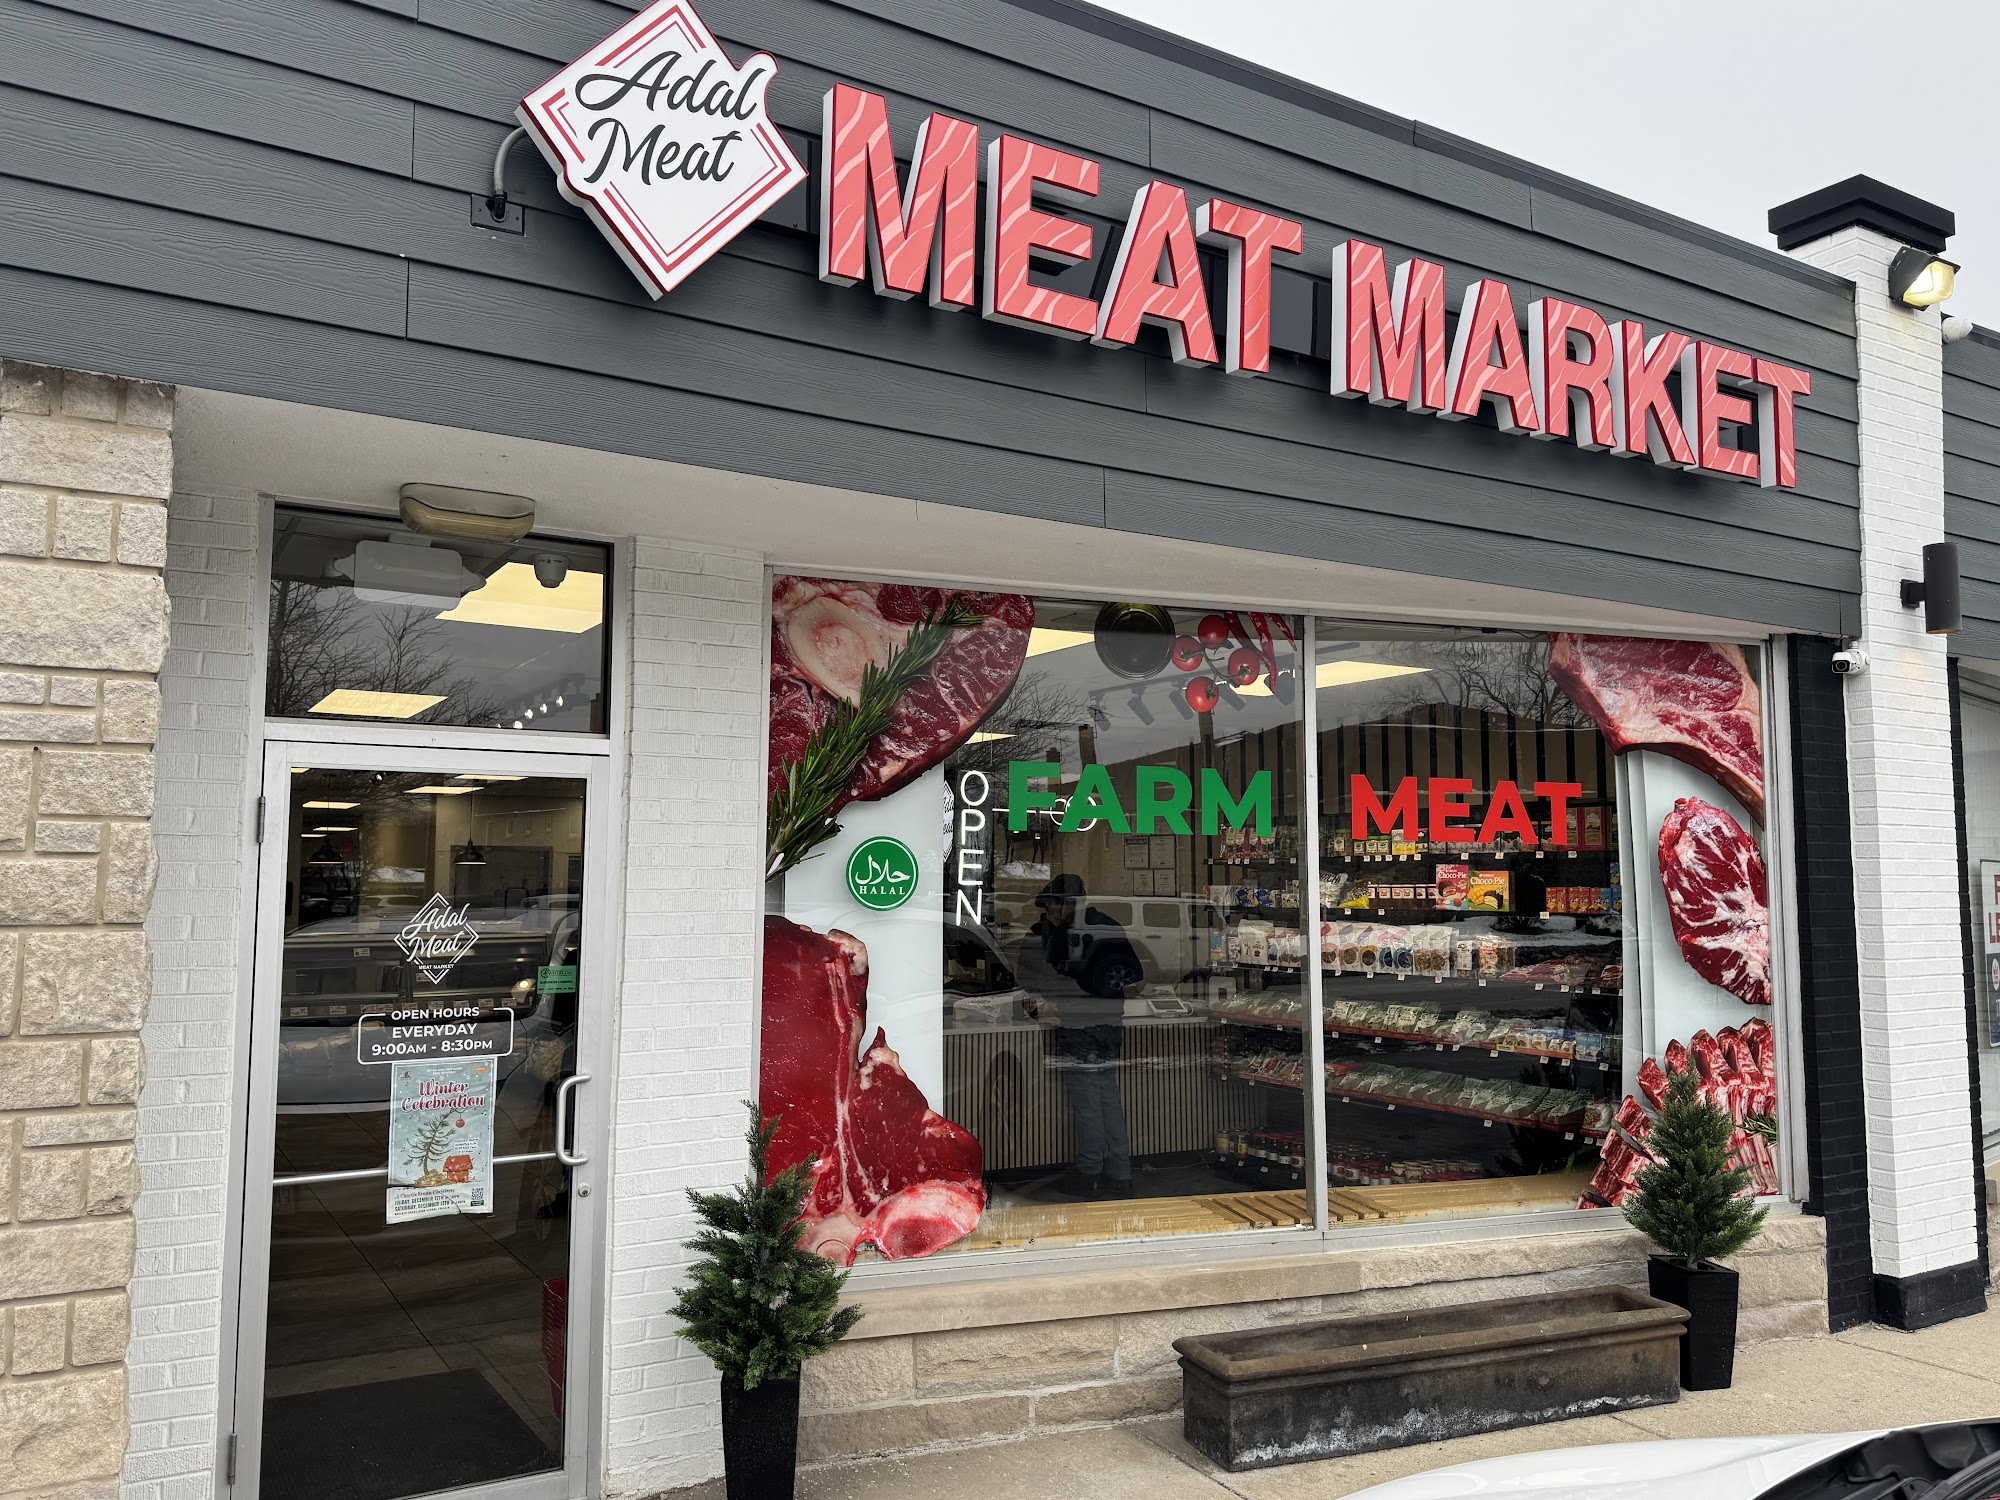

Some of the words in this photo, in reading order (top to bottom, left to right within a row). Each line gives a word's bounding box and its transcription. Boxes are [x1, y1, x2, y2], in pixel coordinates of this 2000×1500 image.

[575, 50, 763, 122] Adal
[583, 117, 742, 187] Meat
[820, 82, 1303, 375] MEAT
[1331, 238, 1812, 489] MARKET
[1007, 761, 1273, 837] FARM
[1351, 773, 1583, 846] MEAT
[955, 770, 989, 927] OPEN
[855, 854, 911, 885] حلال
[859, 885, 905, 895] HALAL
[402, 903, 470, 939] Adal
[406, 931, 465, 962] Meat
[391, 1009, 429, 1020] OPEN
[433, 1006, 480, 1018] HOURS
[392, 1023, 478, 1039] EVERYDAY
[371, 1043, 427, 1056] 9:00AM
[441, 1039, 493, 1052] 8:30PM
[419, 1078, 469, 1096] Winter
[401, 1094, 485, 1112] Celebration
